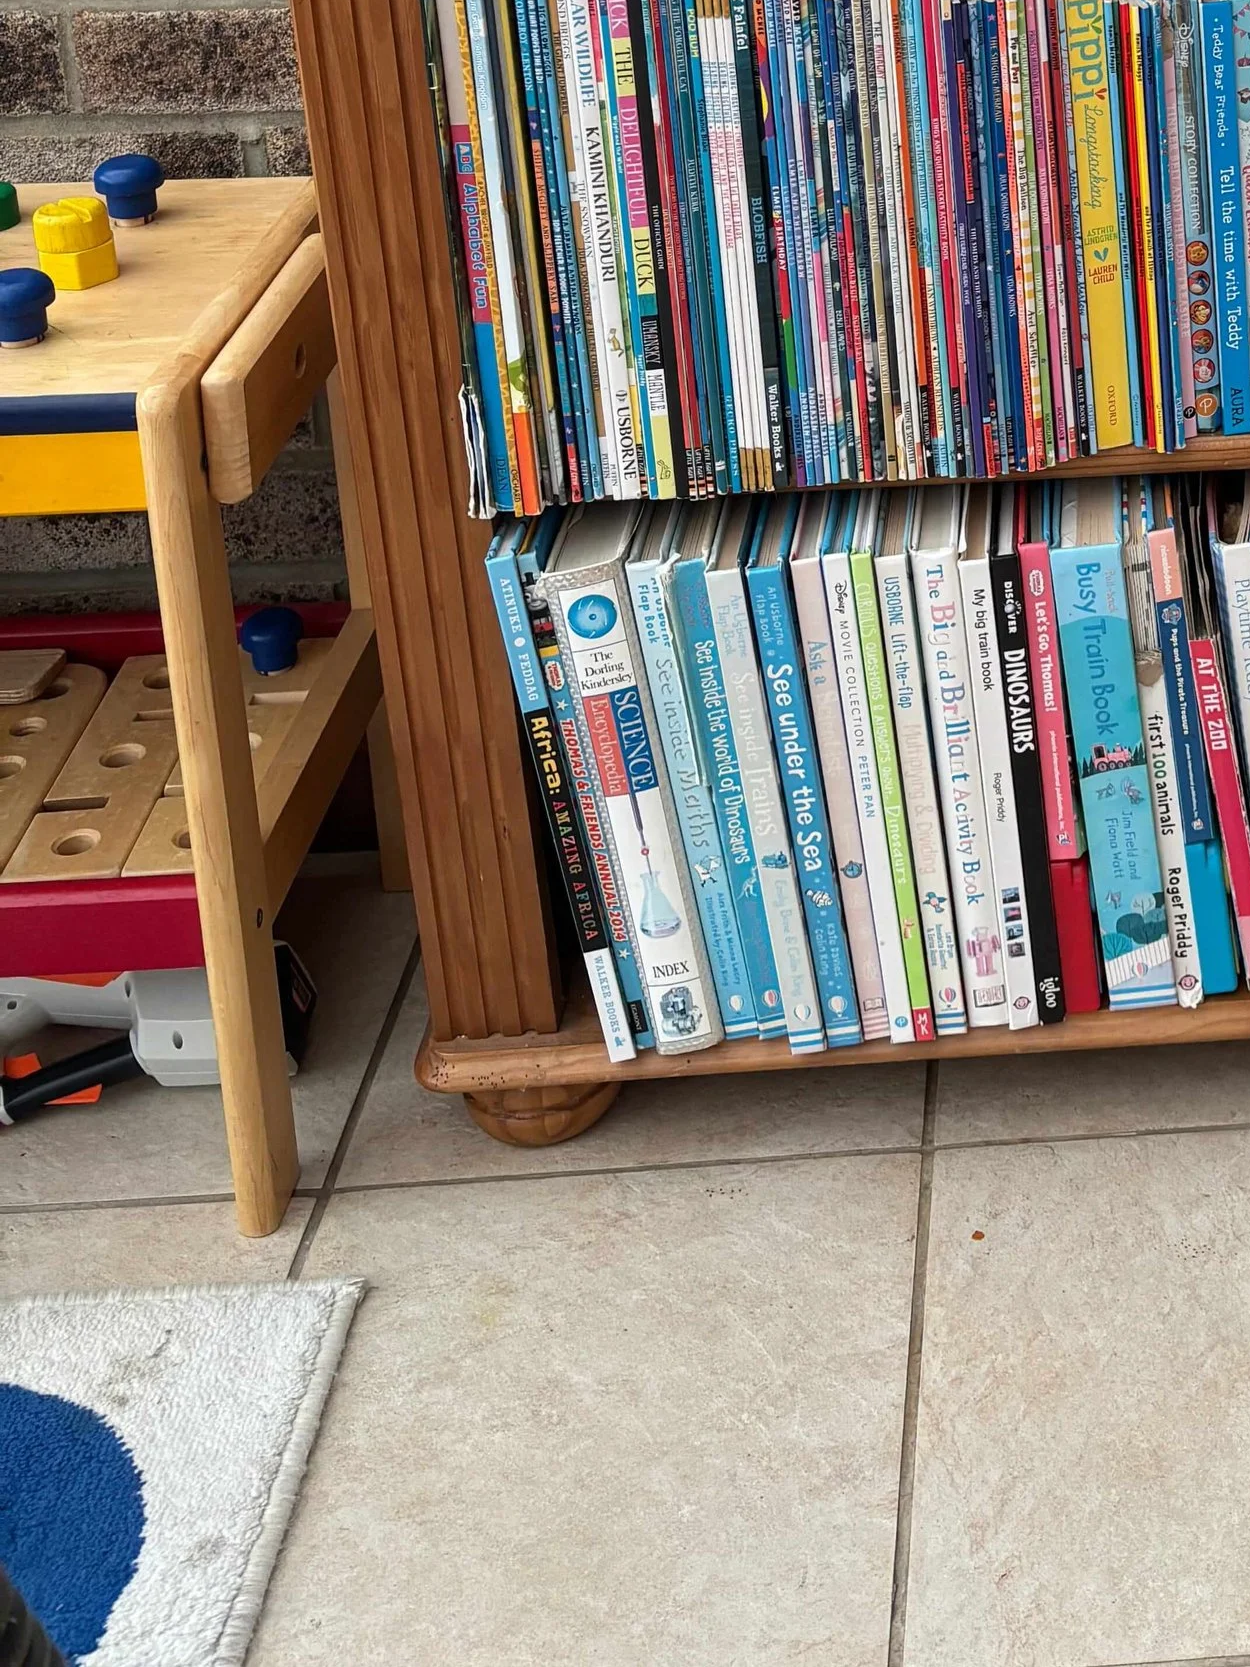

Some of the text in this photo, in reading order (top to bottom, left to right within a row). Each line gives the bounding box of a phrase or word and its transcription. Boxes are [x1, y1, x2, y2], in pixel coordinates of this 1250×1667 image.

[612, 44, 634, 86] THE
[584, 125, 616, 282] KAMINI KHANDURI
[620, 108, 645, 222] DELIGHTFUL
[634, 238, 654, 290] DUCK
[1219, 164, 1241, 351] Tell the time with Teddy
[1002, 647, 1036, 755] DINOSAURS
[1075, 561, 1120, 735] Busy Train Book
[586, 698, 622, 795] Encyclopedia
[614, 690, 652, 794] SCIENCE
[767, 663, 822, 872] See under the Sea
[1147, 710, 1175, 836] first 100 animals
[1166, 865, 1192, 959] Roger Priddy
[652, 961, 689, 979] INDEX
